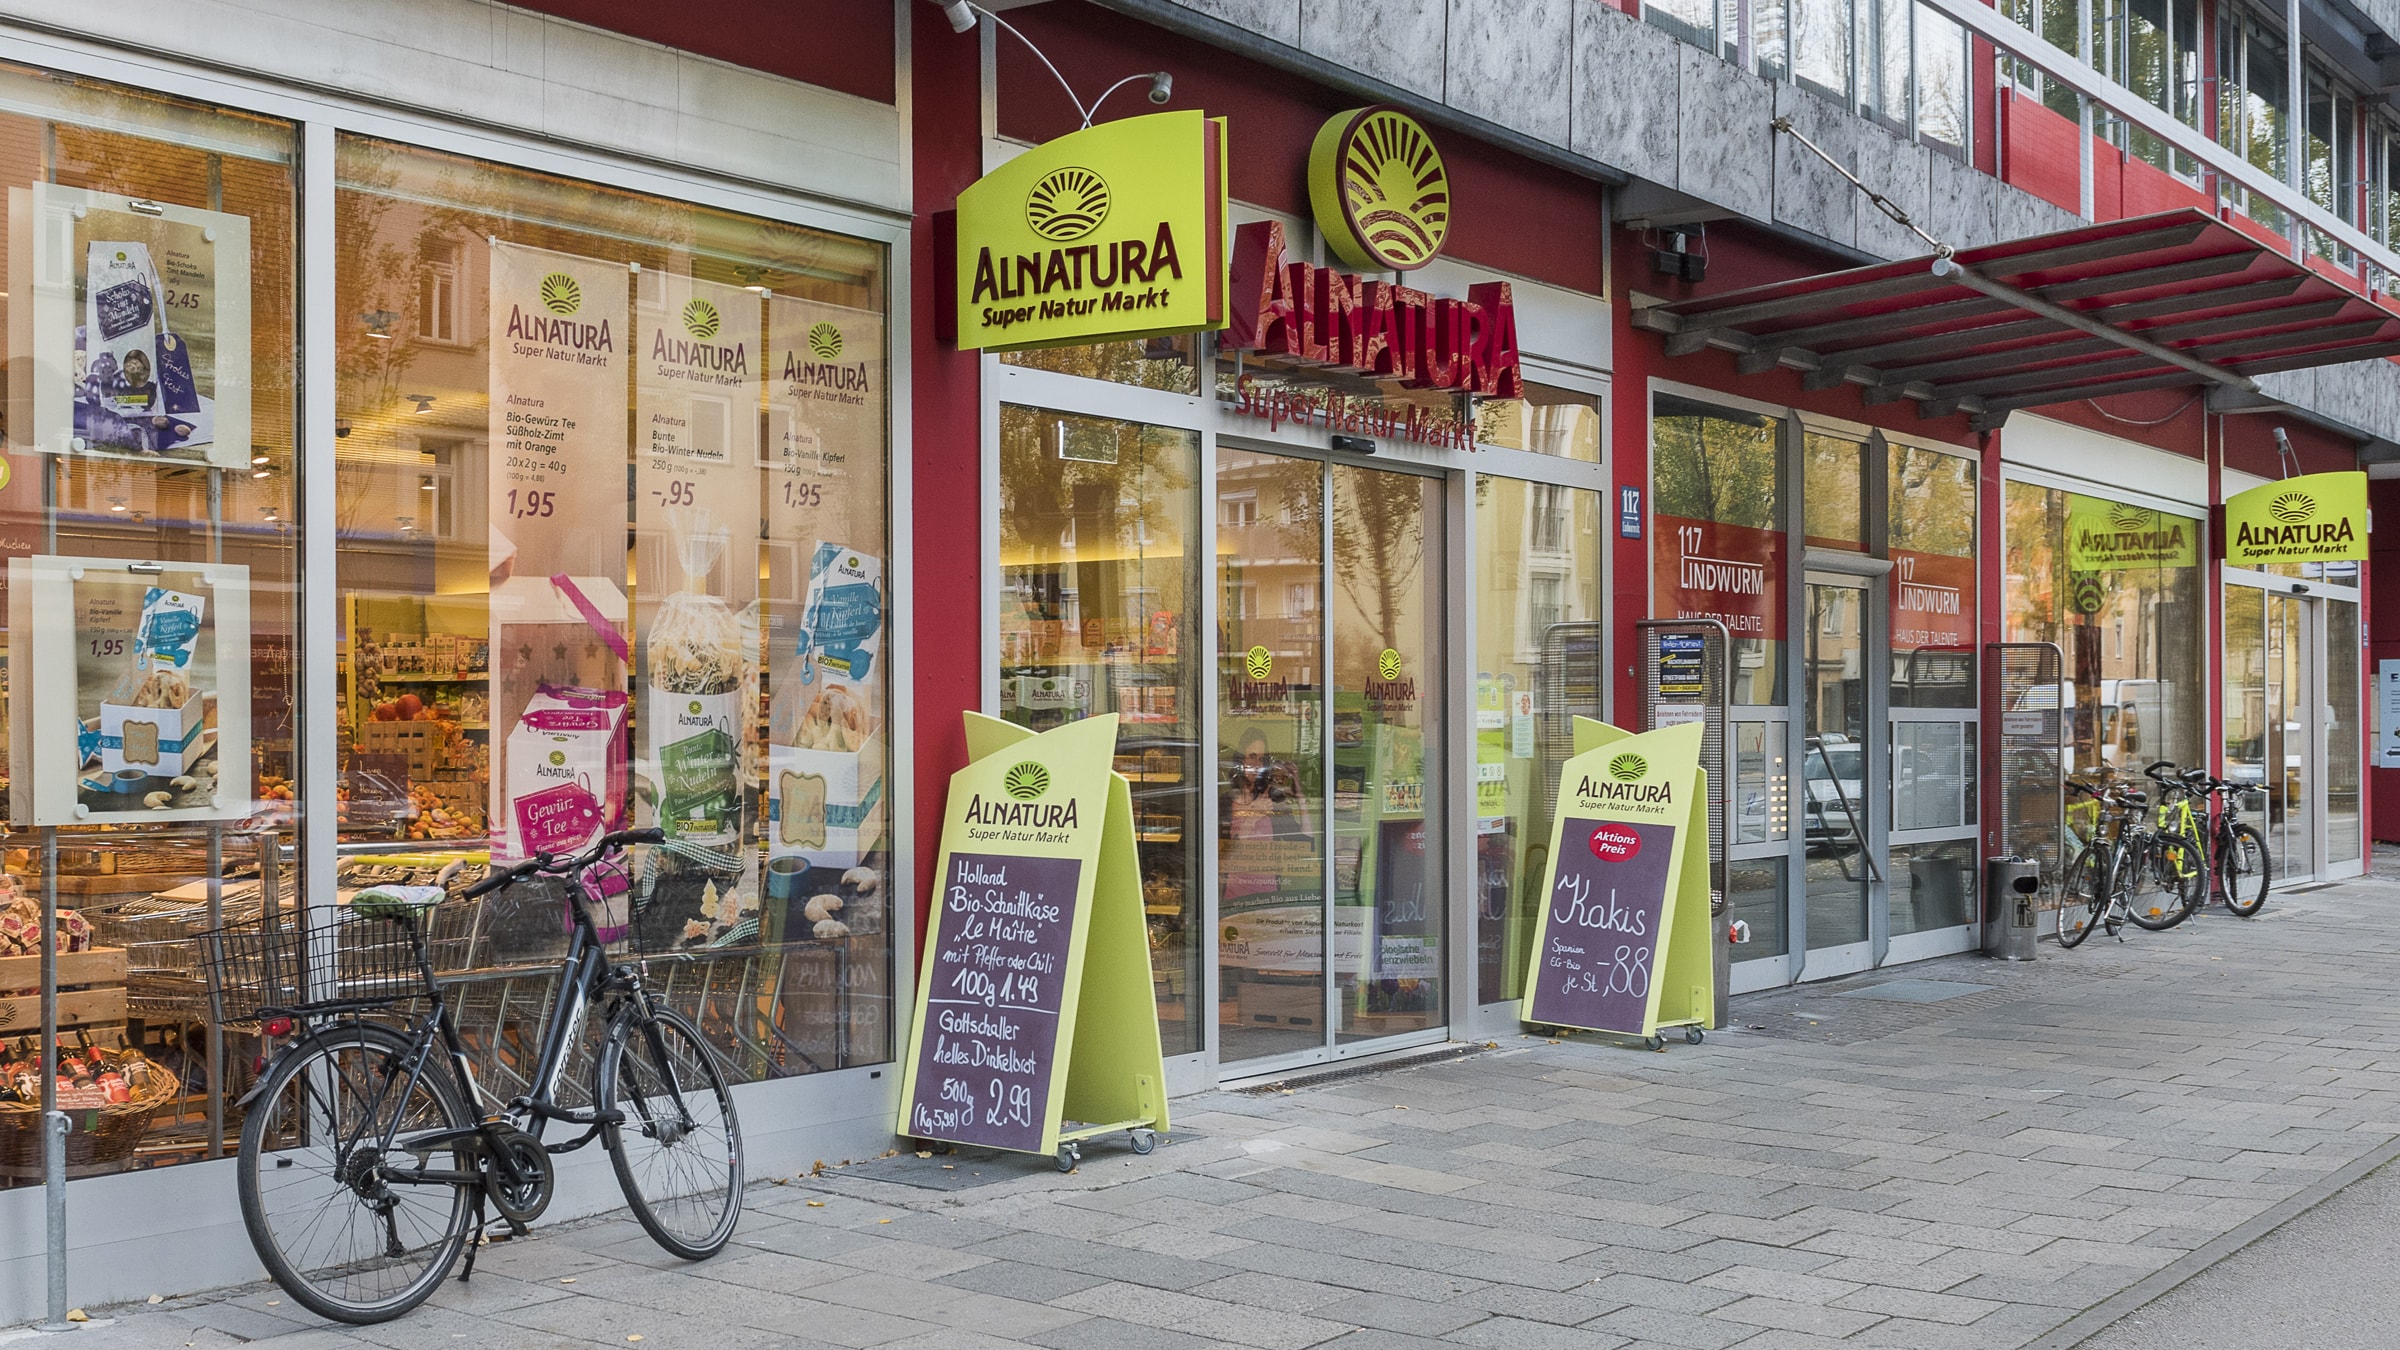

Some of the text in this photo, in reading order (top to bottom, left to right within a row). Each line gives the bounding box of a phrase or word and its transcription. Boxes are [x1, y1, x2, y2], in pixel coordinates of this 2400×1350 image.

[971, 221, 1183, 304] ALNATURA
[166, 289, 200, 309] 2,45
[981, 287, 1170, 329] Super Natur Markt
[1232, 220, 1525, 400] ALNATURA
[506, 304, 613, 353] ALNATURA
[512, 342, 607, 367] Super Natur Markt
[652, 328, 747, 375] ALNATURA
[657, 364, 742, 388] Super Natur Markt
[783, 350, 868, 393] ALNATURA
[506, 394, 545, 408] Alnatura
[788, 385, 864, 406] Super Natur Markt
[506, 411, 576, 430] Bio-Gewürz Tee
[652, 413, 686, 427] Alnatura
[1234, 373, 1477, 453] Super Natur Markt
[506, 425, 565, 441] Süßholz-Zimt
[652, 430, 675, 442] Bunte
[783, 432, 813, 444] Alnatura
[506, 440, 557, 455] mit Orange
[652, 443, 724, 460] Bio-Winter Nudeln
[783, 447, 846, 463] Bio-Vanille Kipferl
[507, 489, 556, 519] 1,95
[784, 480, 822, 508] 1,95
[1622, 489, 1640, 514] 117
[1678, 525, 1703, 556] 117
[2236, 517, 2355, 546] ALNATURA
[2242, 544, 2348, 558] Super Natur Markt
[838, 564, 866, 579] ALNATURA
[1681, 557, 1764, 595] LINDWURM
[1896, 555, 1915, 582] 117
[1898, 583, 1960, 615] LINDWURM
[89, 608, 123, 616] Bio-Vanille
[1895, 628, 1929, 644] HAUS DER
[90, 639, 124, 658] 1,95
[1031, 689, 1065, 698] ALNATURA
[1230, 675, 1289, 701] ALNATURA
[1364, 676, 1416, 701] ALNATURA
[678, 713, 713, 727] ALNATURA
[536, 763, 576, 779] ALNATURA
[674, 751, 714, 773] Winter
[676, 765, 718, 791] Nudeln
[1576, 775, 1672, 804] ALNATURA
[527, 798, 574, 826] Gewürz
[964, 793, 1078, 829] ALNATURA
[1578, 799, 1665, 815] Super Natur Markt
[542, 818, 567, 836] Tee
[968, 828, 1070, 844] Super Natur Markt
[1593, 831, 1637, 846] Aktions
[1599, 843, 1627, 855] Preis
[957, 860, 1008, 886] Holland
[949, 885, 1060, 923] Bio-Schnittkäse
[1299, 893, 1321, 901] Liebe
[1553, 873, 1646, 936] Kakis
[1552, 937, 1585, 955] Spanien
[942, 943, 1055, 974] mit Pfeffer oder Chili
[1550, 956, 1581, 970] EG-Bio
[951, 968, 1039, 1008] 100g 1.49
[1562, 973, 1579, 994] je
[939, 1009, 1020, 1041] Gottschaller
[933, 1034, 1037, 1076] helles Dinkelbrot
[940, 1078, 1032, 1128] 500g 2.99
